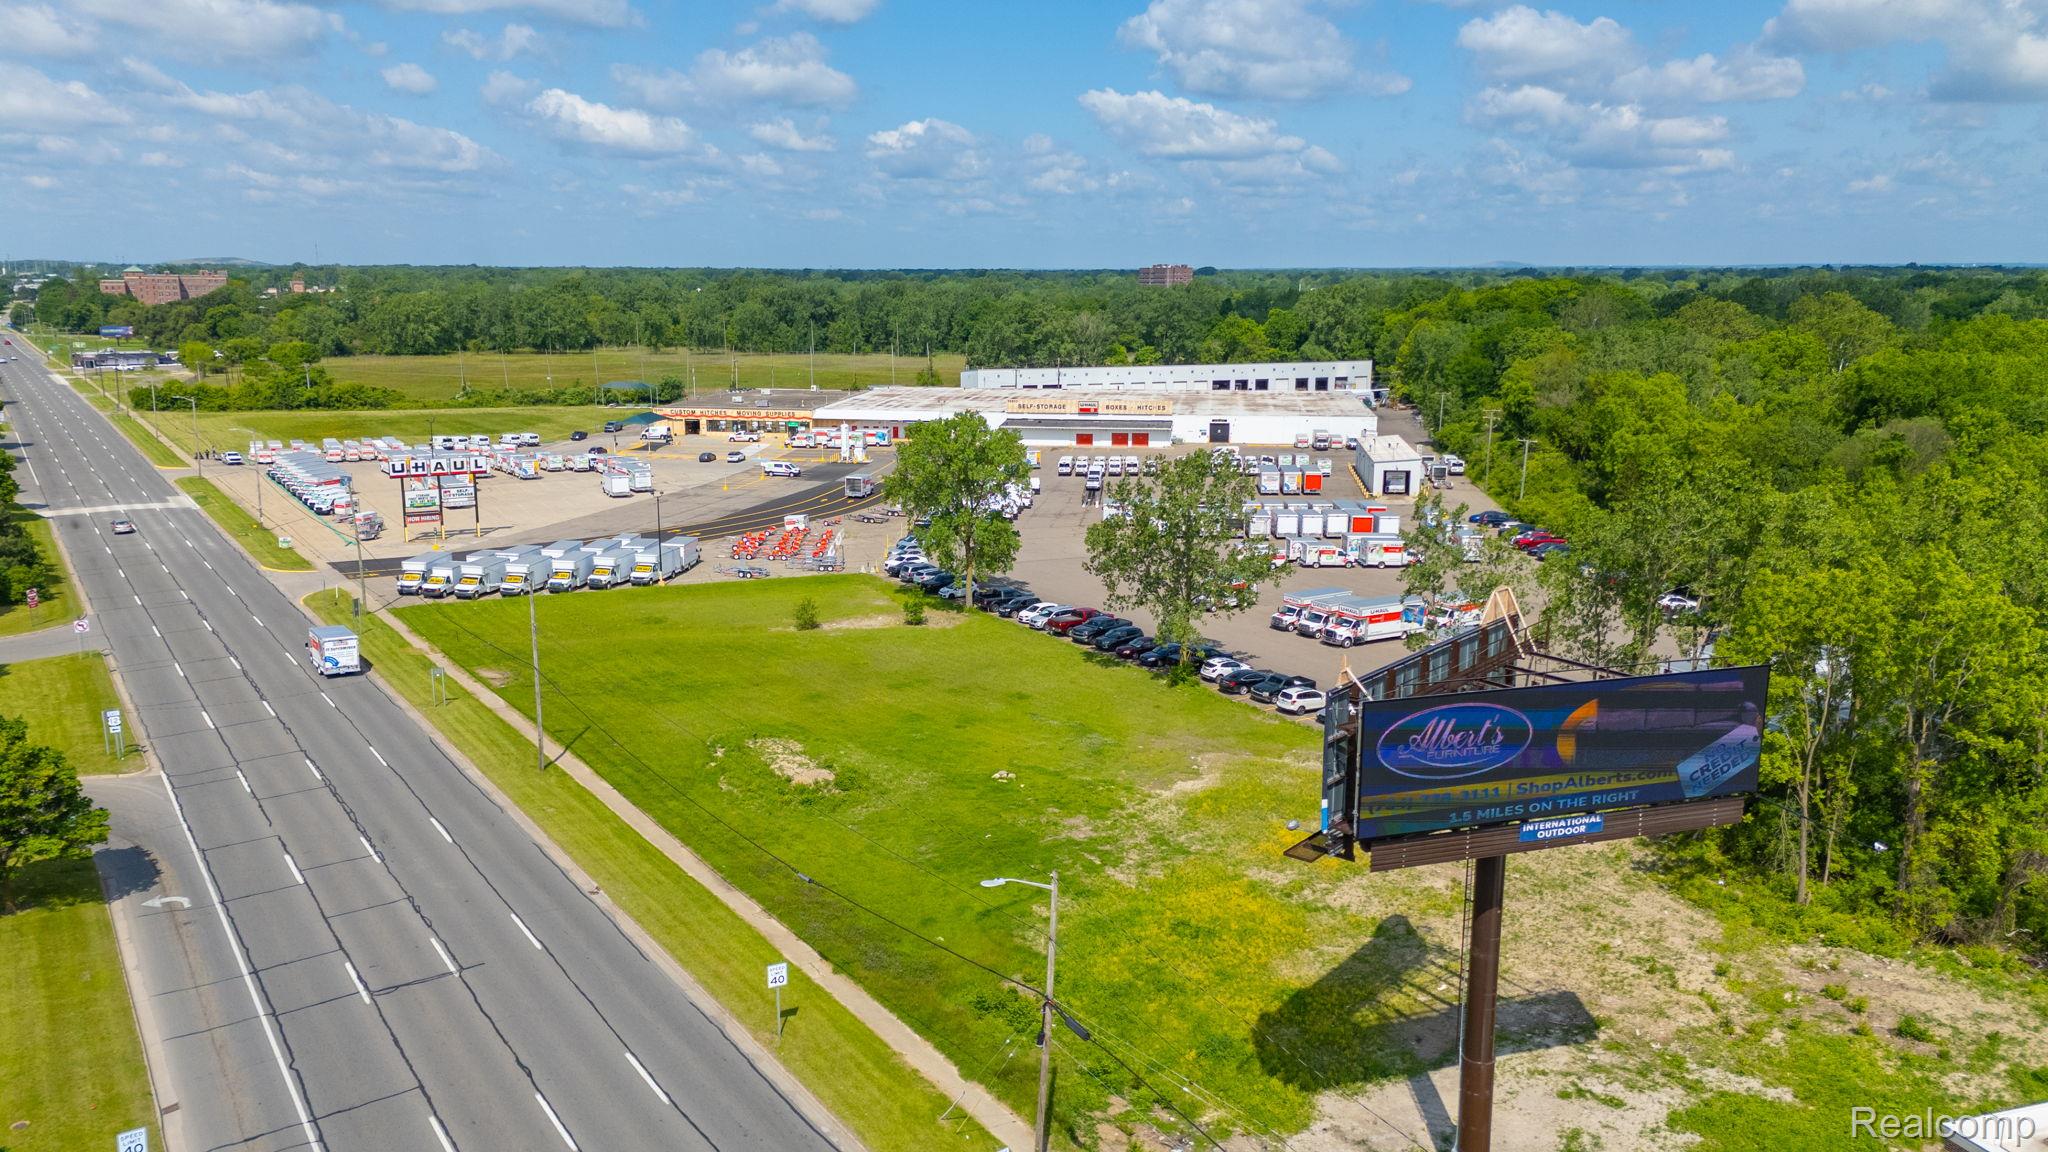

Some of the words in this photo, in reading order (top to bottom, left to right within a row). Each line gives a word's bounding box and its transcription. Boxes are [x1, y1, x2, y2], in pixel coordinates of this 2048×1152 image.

[1398, 714, 1504, 753] Albert's
[1427, 745, 1500, 760] FURNITURE
[1516, 768, 1674, 796] ShopAlberts.com
[1450, 812, 1471, 823] 1.5
[1477, 805, 1524, 821] MILES
[1529, 801, 1552, 812] ON
[1556, 797, 1587, 809] THE
[1592, 790, 1640, 805] RIGHT
[1523, 814, 1602, 831] INTERNATIONAL
[1537, 825, 1586, 839] OUTDOOR
[770, 975, 785, 984] 40
[120, 1131, 143, 1141] SPEED
